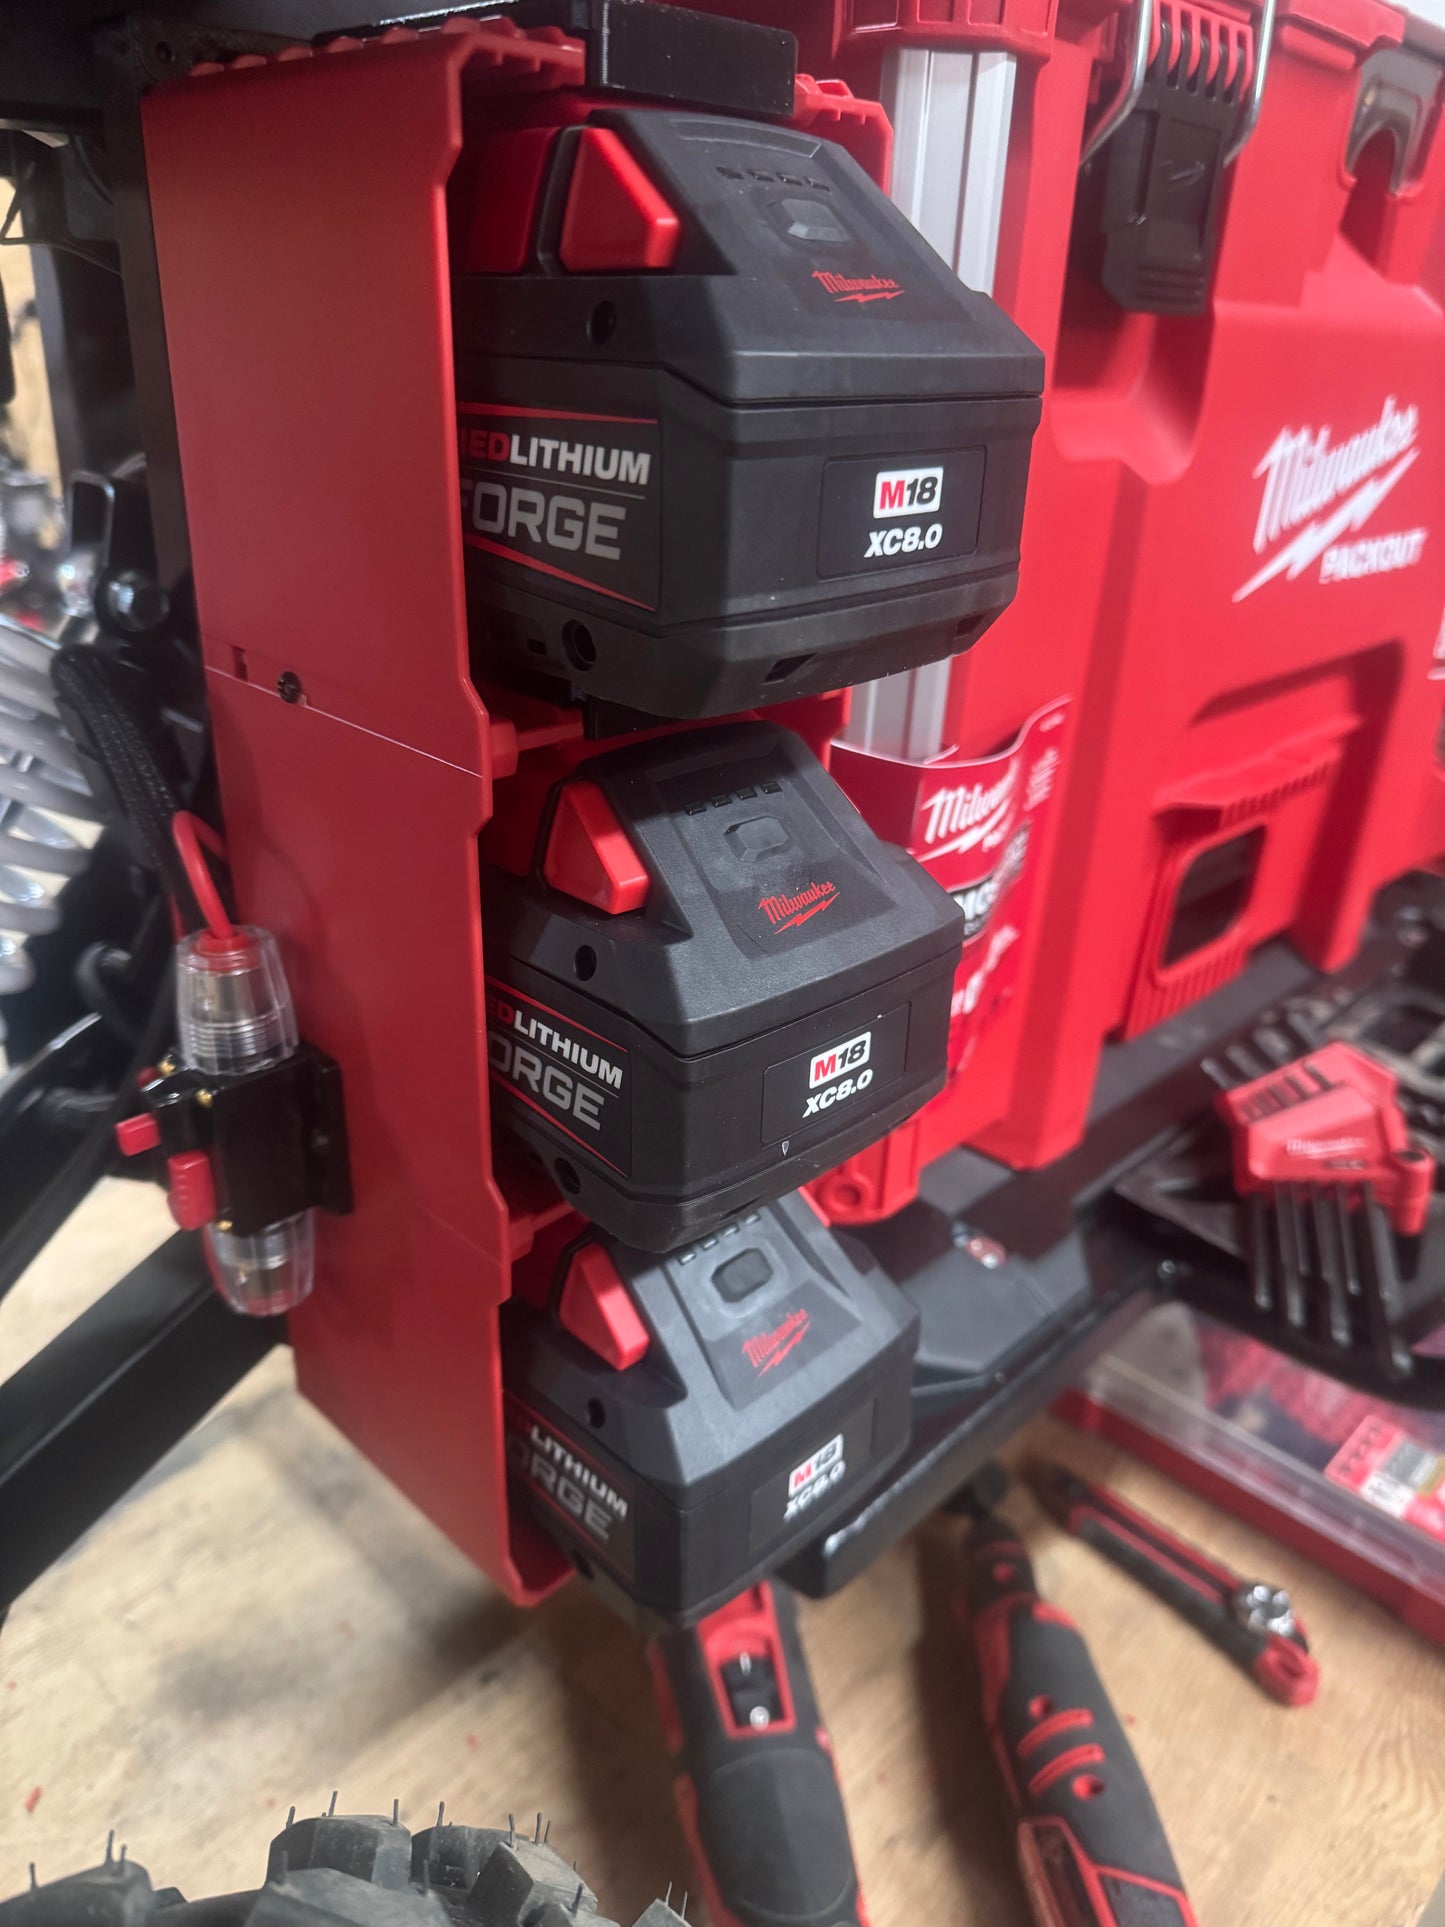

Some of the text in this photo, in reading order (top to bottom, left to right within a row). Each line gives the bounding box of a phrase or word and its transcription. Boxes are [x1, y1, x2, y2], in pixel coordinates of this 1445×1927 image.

[812, 270, 900, 294] Milwaukee
[879, 476, 938, 510] M18
[1252, 394, 1420, 555] Milwaukee
[864, 523, 943, 558] XC8.0
[757, 881, 836, 925] Milwaukee
[814, 1040, 867, 1081] M18
[802, 1069, 873, 1118] XC8.0
[793, 1445, 838, 1488] M18
